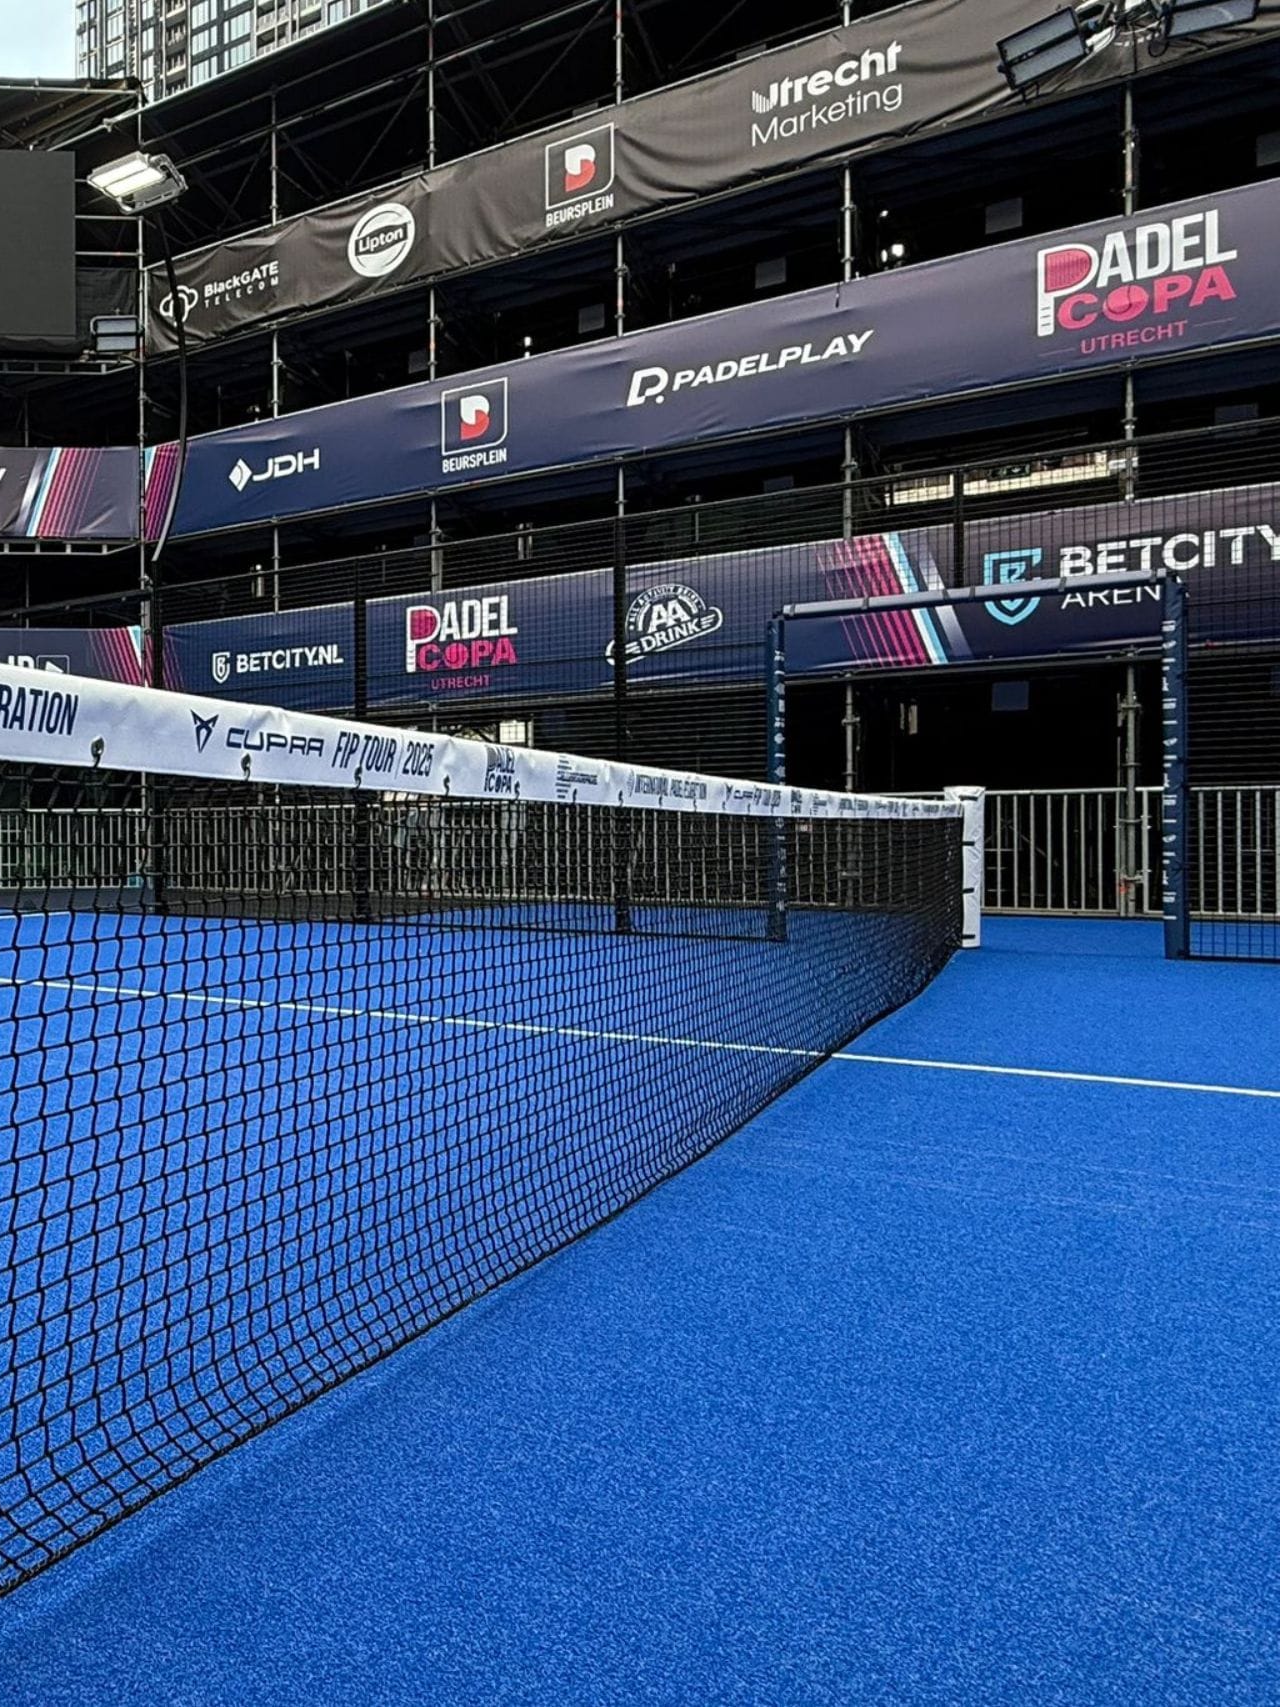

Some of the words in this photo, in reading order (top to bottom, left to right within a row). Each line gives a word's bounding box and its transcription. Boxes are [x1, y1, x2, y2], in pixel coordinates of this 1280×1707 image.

[752, 83, 903, 147] Marketing
[546, 193, 615, 228] BEURSPLEIN
[358, 227, 404, 253] Lipton
[204, 260, 279, 298] BlackGATE
[1037, 209, 1238, 337] PADEL
[204, 276, 279, 308] TELECOM
[1058, 265, 1237, 330] COPA
[1080, 320, 1189, 355] UTRECHT
[672, 329, 874, 392] PADELPLAY
[252, 447, 320, 482] JDH
[442, 448, 507, 473] BEURSPLEIN
[1060, 524, 1280, 578] BETCITY
[1061, 574, 1190, 610] AREN
[406, 594, 518, 673] PADEL
[647, 599, 691, 634] AA
[640, 617, 700, 652] DRINK
[236, 643, 344, 673] BETCITY.NL
[418, 636, 517, 671] COPA
[431, 674, 491, 690] UTRECHT
[227, 727, 324, 757] CUPRA
[331, 731, 361, 768] FIP
[360, 735, 397, 773] TOUR
[402, 741, 434, 777] 2025
